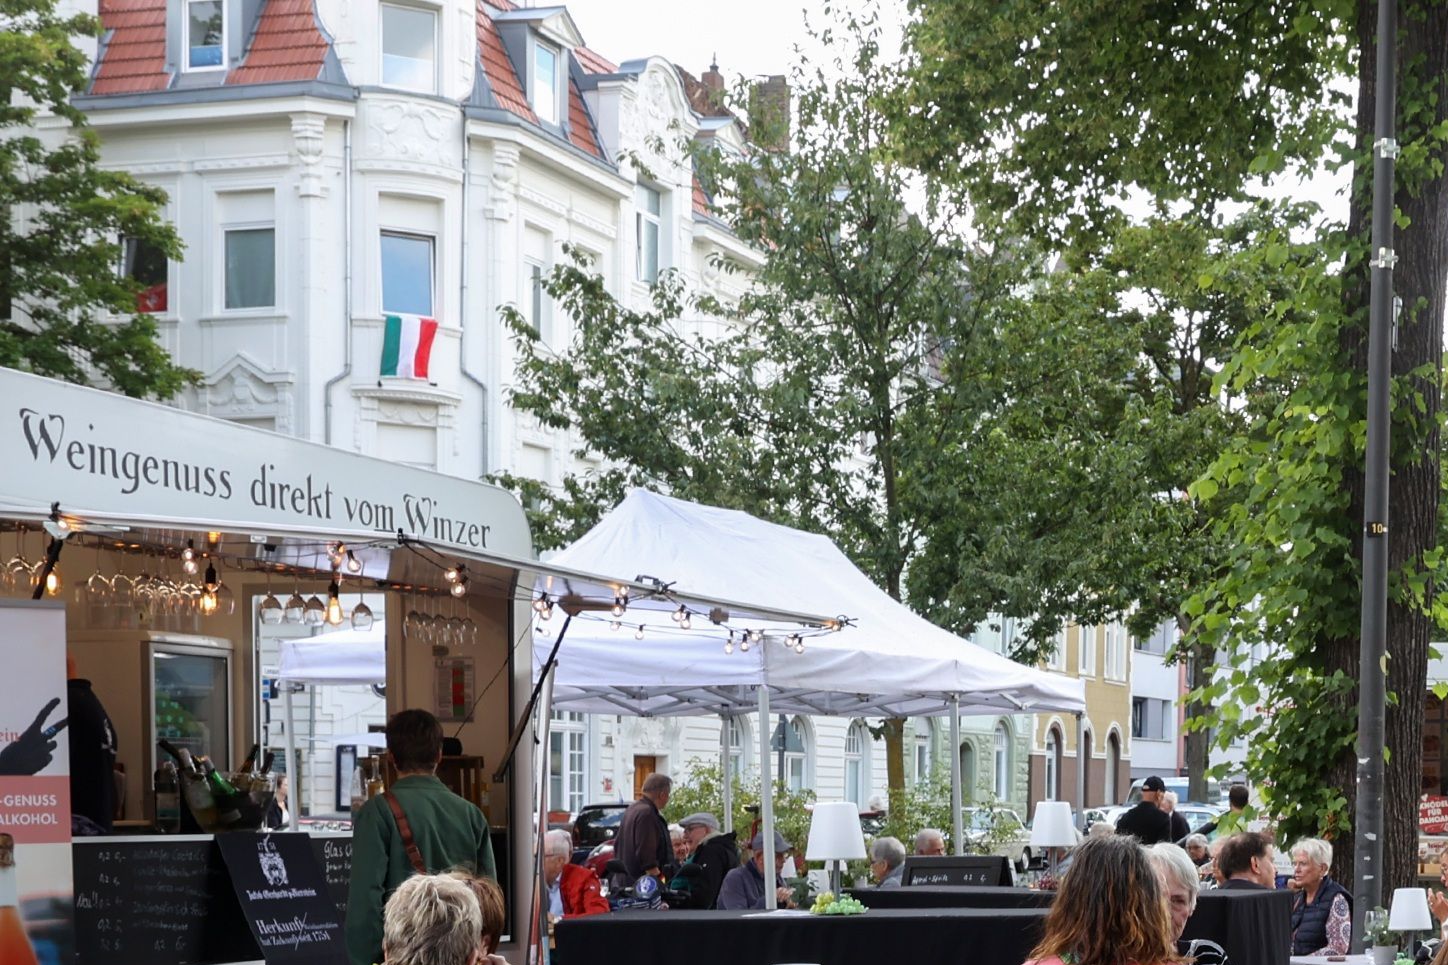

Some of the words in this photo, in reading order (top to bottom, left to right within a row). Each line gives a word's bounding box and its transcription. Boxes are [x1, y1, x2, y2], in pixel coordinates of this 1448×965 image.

[18, 407, 233, 500] Weingenuss
[250, 462, 333, 520] direkt
[343, 496, 395, 533] vom
[403, 493, 491, 550] Winzer
[1427, 808, 1442, 816] FÜR
